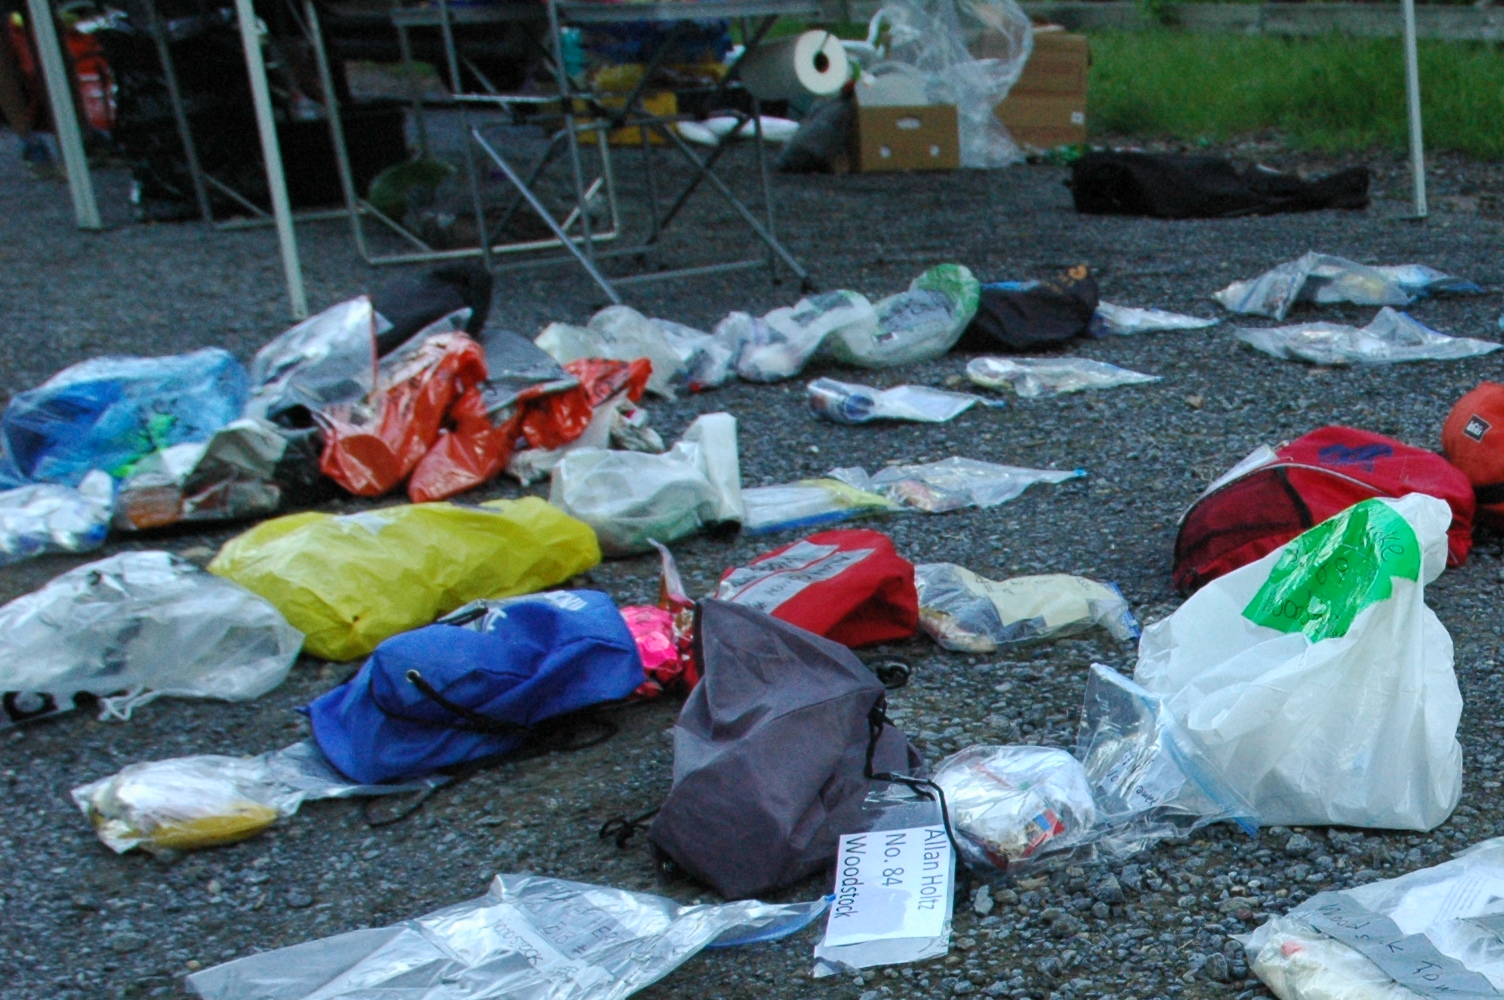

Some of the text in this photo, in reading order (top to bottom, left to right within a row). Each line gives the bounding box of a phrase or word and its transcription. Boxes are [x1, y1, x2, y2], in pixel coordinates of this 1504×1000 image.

[833, 835, 868, 920] Woodstock
[917, 828, 947, 910] Allan Holtz
